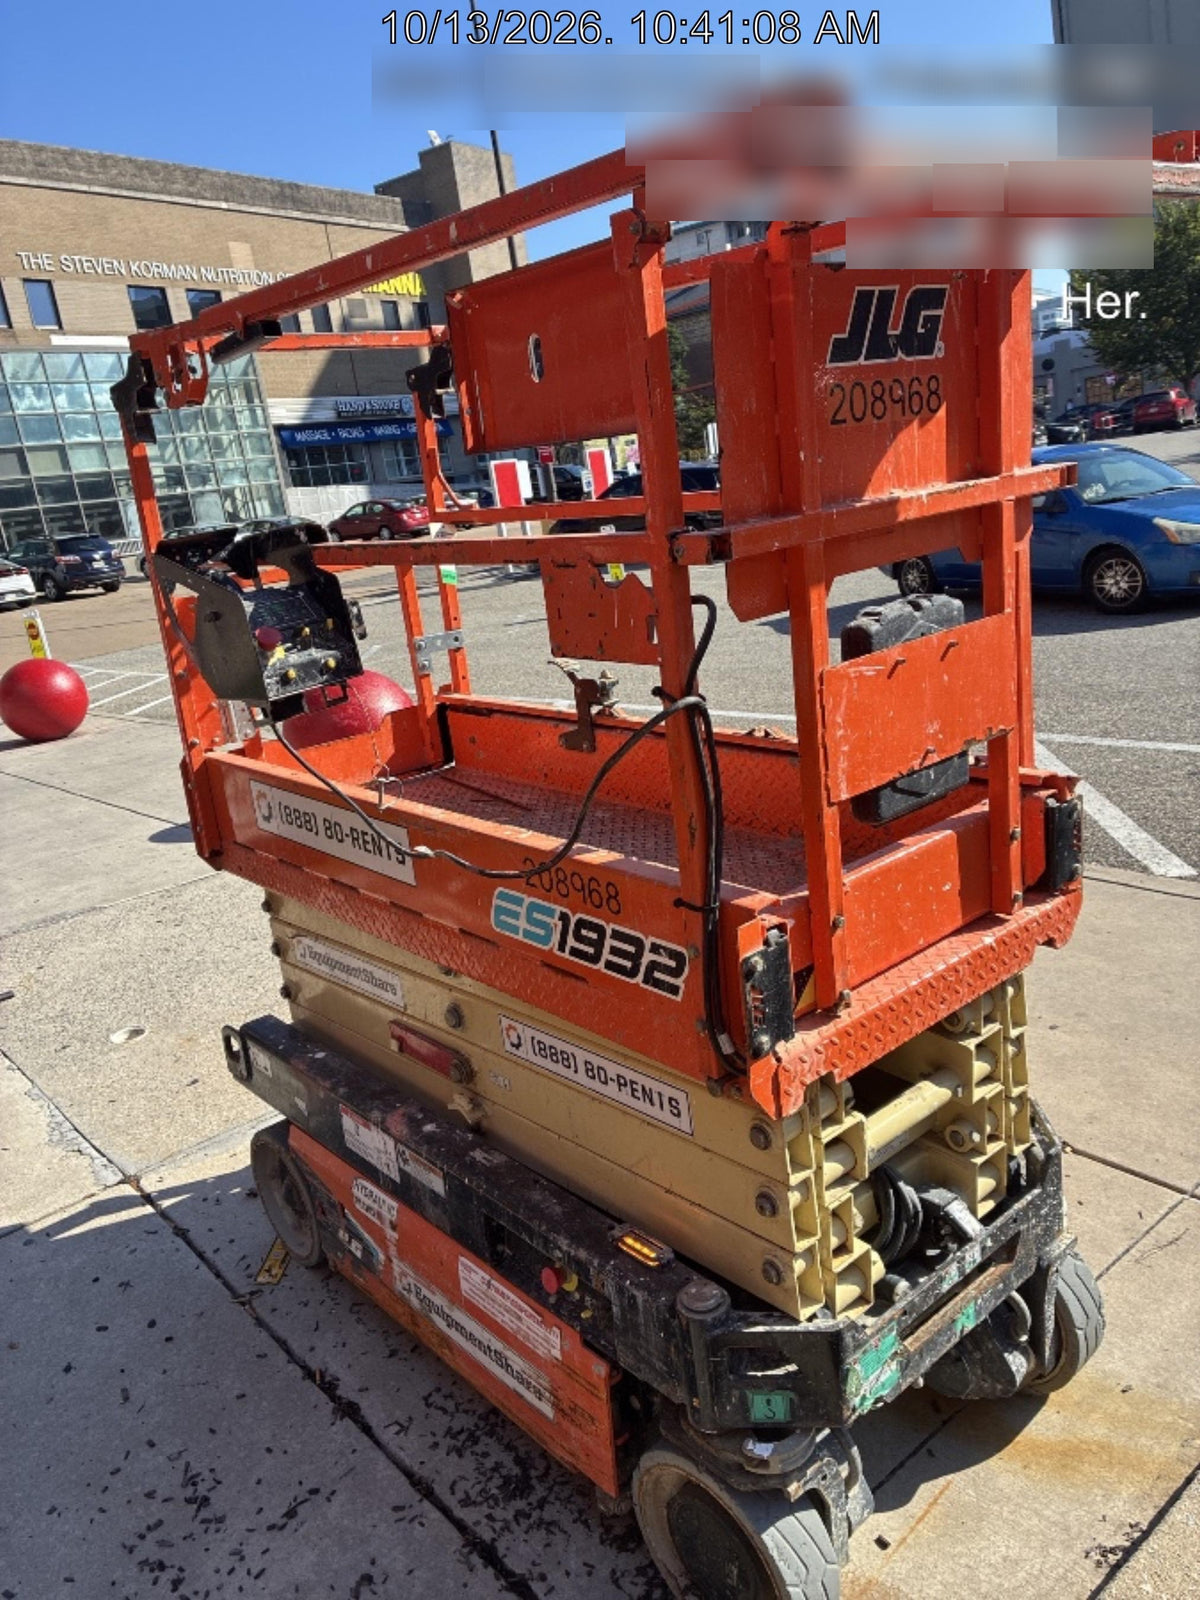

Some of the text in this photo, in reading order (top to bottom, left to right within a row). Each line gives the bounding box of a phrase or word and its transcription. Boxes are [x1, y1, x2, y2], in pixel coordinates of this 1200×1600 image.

[16, 251, 55, 271] THE
[60, 255, 127, 277] STEVEN
[130, 260, 199, 282] KORMAN
[200, 266, 275, 287] NUTRITION
[825, 284, 950, 368] JLG
[829, 374, 942, 426] 208968
[278, 801, 406, 866] (888) 80-RENTS
[522, 857, 622, 916] 208968
[491, 887, 688, 1002] ES1932
[530, 1035, 579, 1074] (888)
